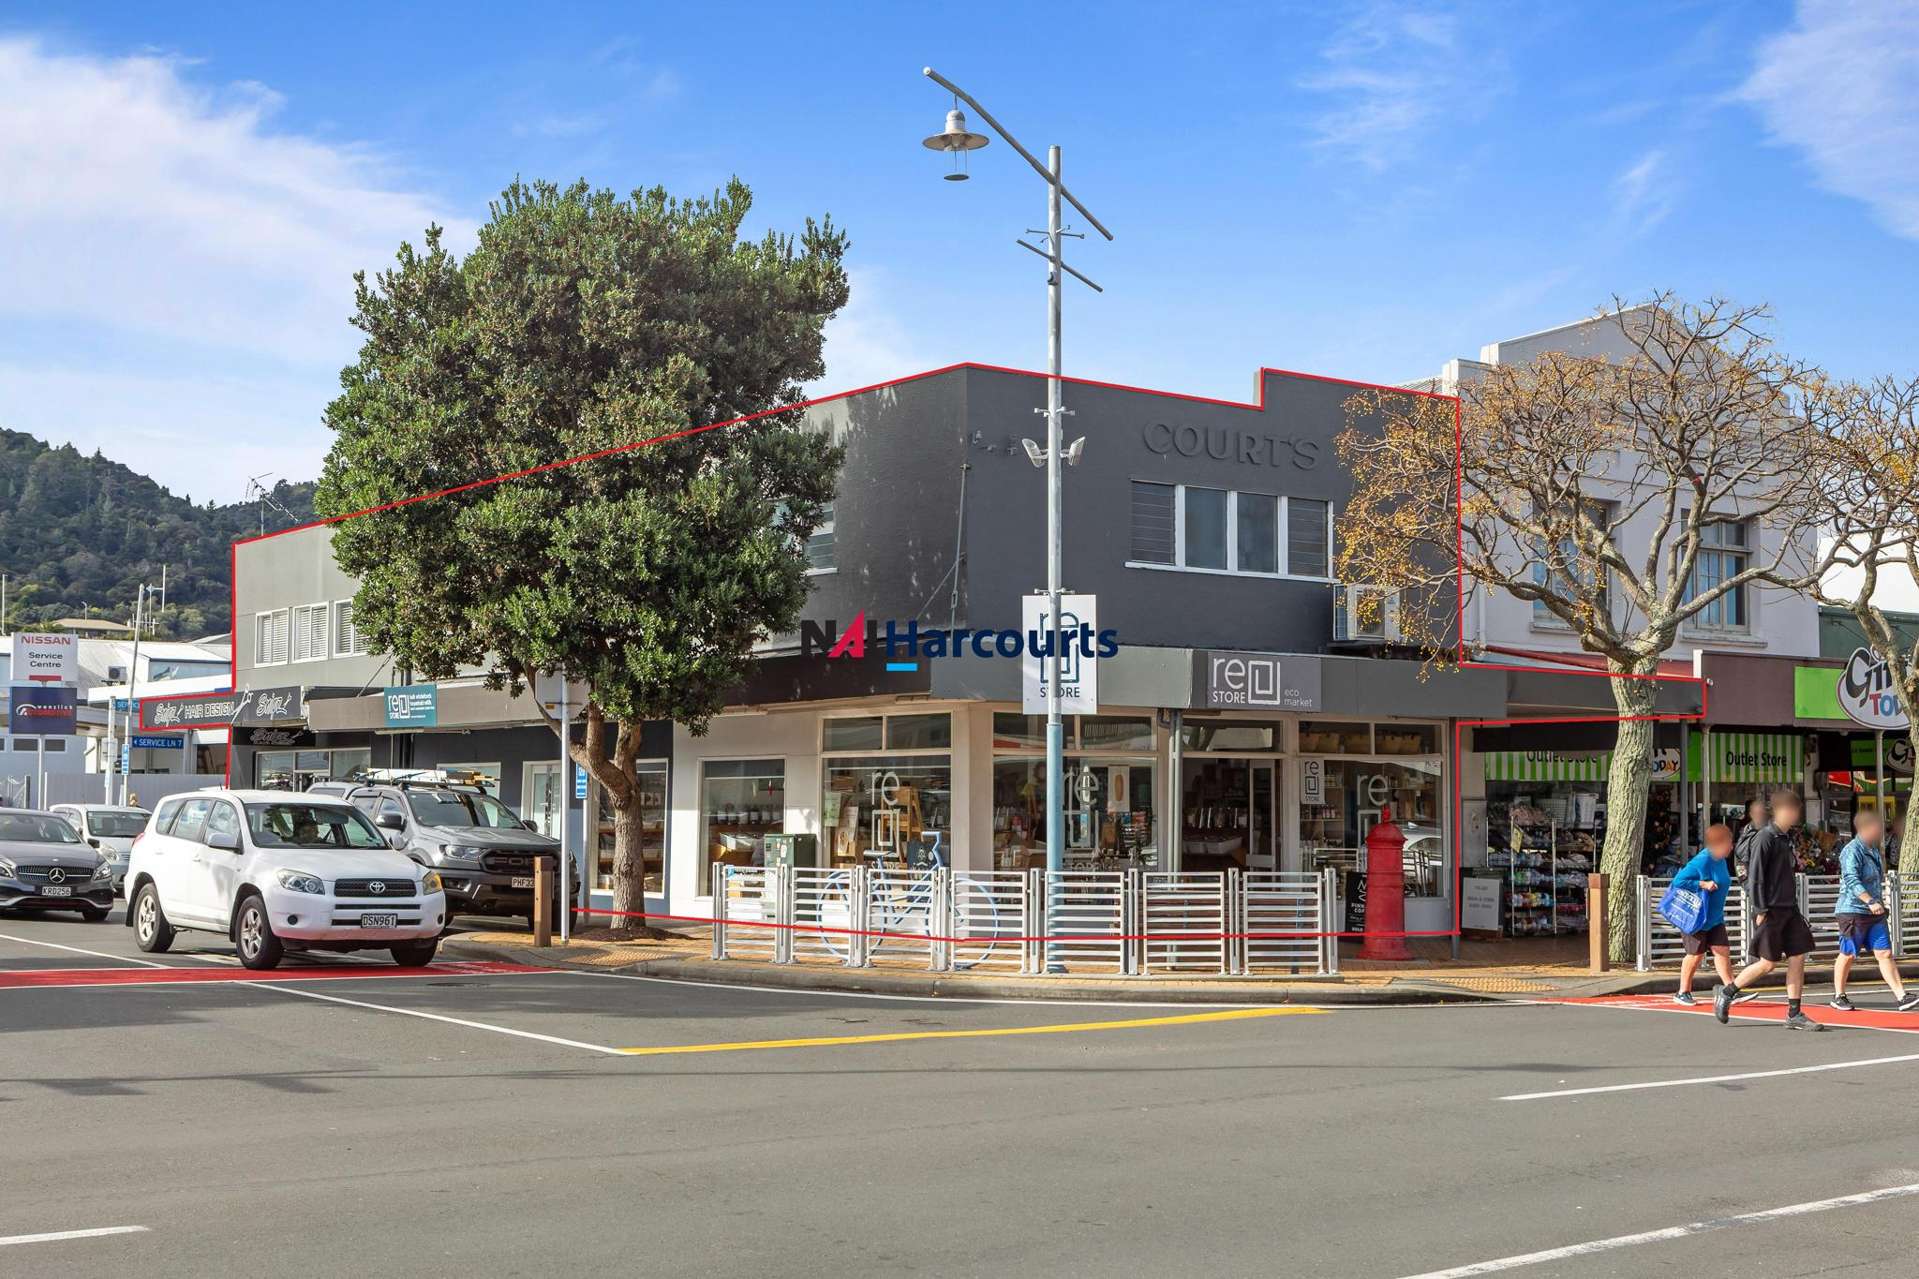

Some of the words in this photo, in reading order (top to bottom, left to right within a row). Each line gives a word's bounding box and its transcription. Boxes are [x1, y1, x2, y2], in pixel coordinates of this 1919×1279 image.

[21, 635, 71, 646] NISSAN
[28, 651, 63, 660] Service
[1212, 690, 1246, 704] STORE
[1284, 689, 1299, 697] eco
[1283, 698, 1312, 707] market
[184, 703, 204, 719] HAIR
[204, 701, 235, 717] DESIGN
[138, 737, 166, 746] SERVICE
[167, 739, 176, 747] LN
[178, 739, 183, 747] 7
[1726, 751, 1759, 766] Outlet
[1761, 752, 1788, 767] Store
[364, 916, 396, 926] DSN961
